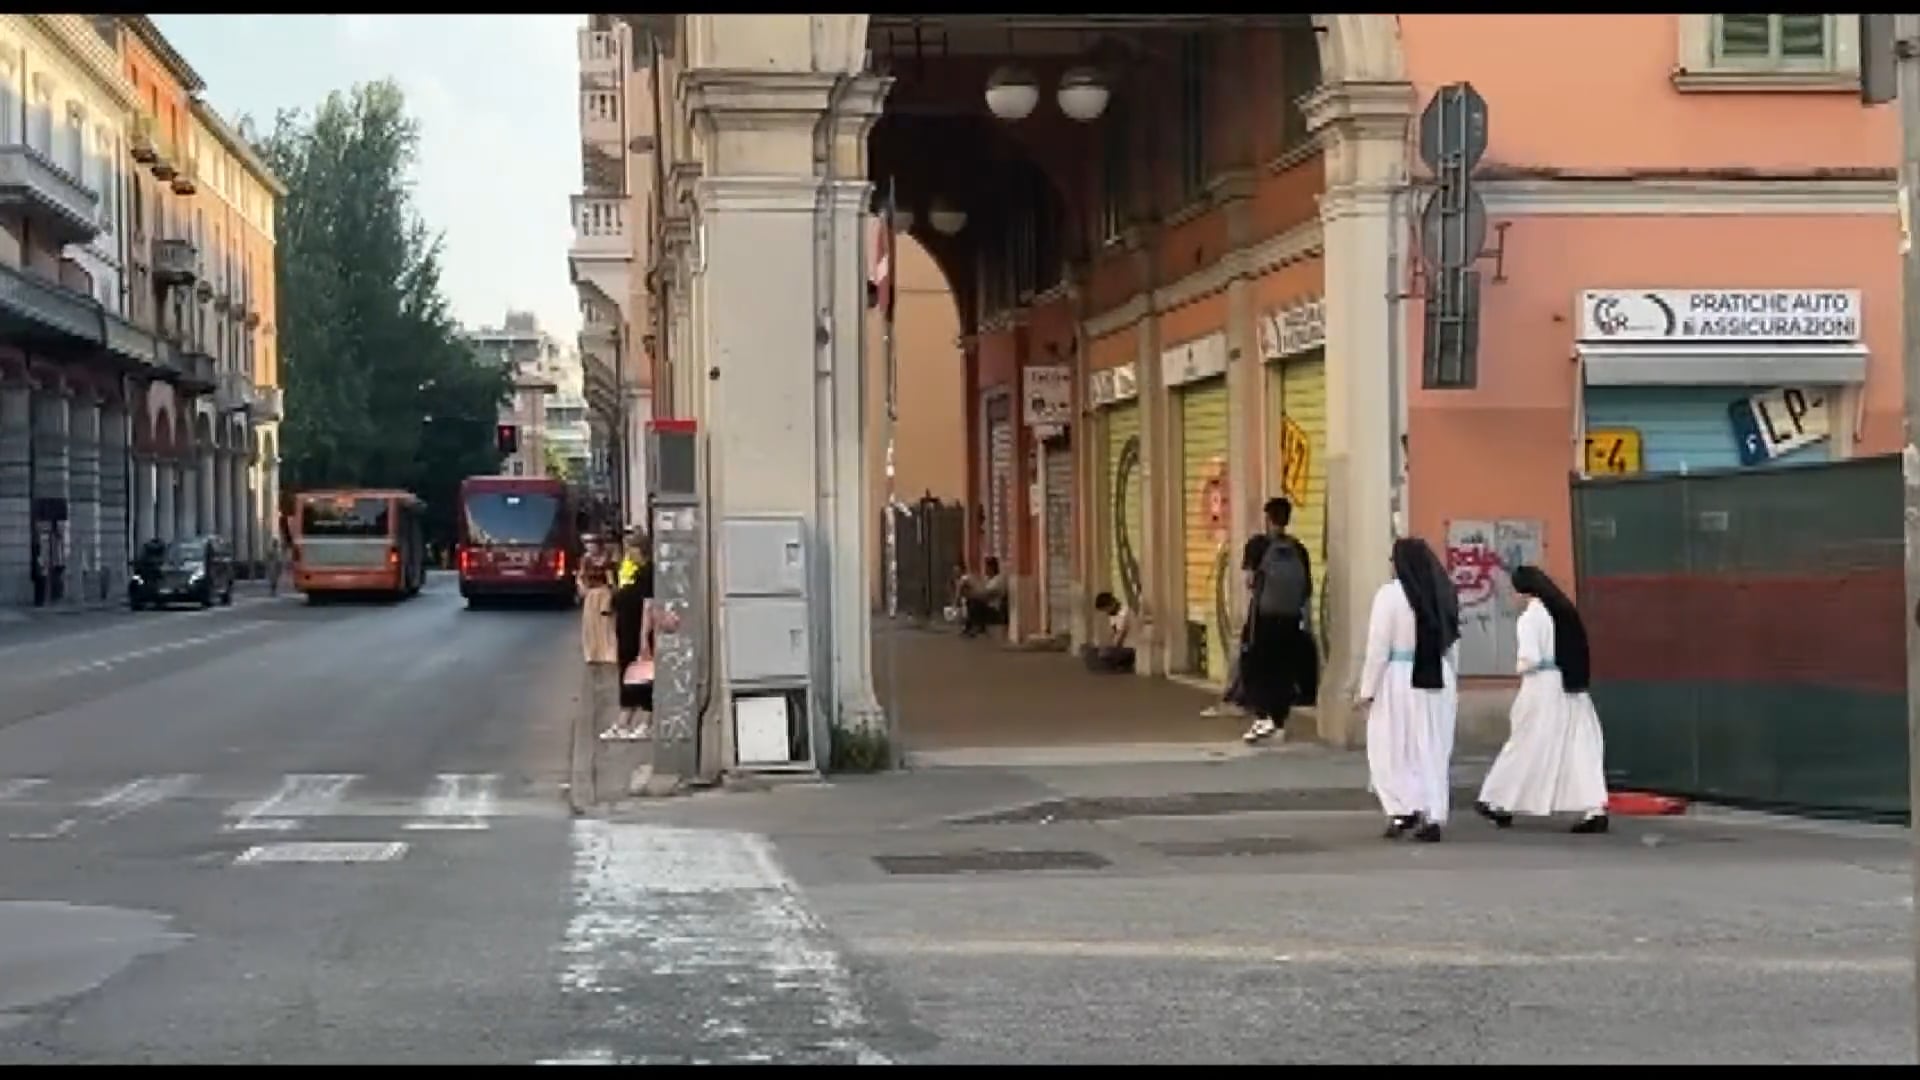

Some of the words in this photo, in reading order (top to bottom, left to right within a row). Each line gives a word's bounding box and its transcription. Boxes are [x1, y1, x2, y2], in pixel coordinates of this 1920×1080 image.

[1690, 294, 1788, 313] PRATICHE
[1793, 294, 1849, 313] AUTO
[1700, 316, 1857, 336] ASSICURAZIONI
